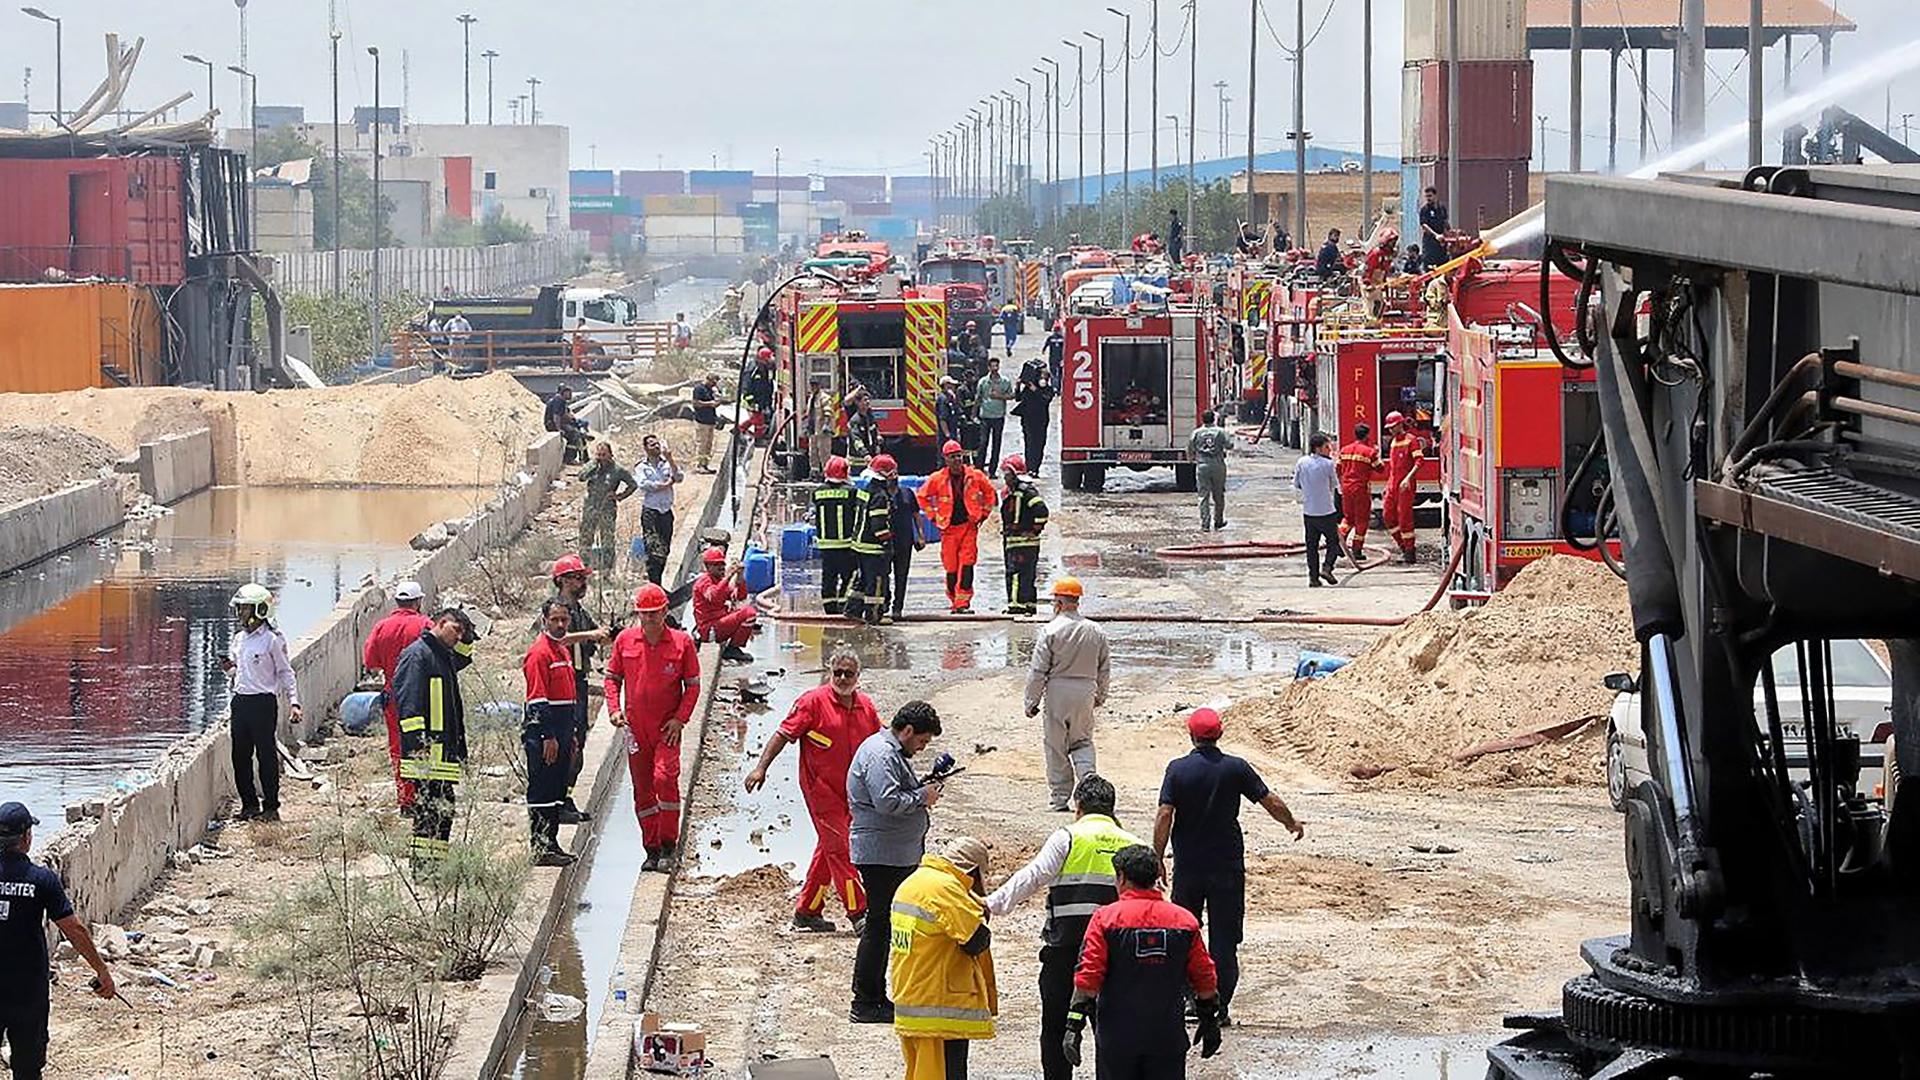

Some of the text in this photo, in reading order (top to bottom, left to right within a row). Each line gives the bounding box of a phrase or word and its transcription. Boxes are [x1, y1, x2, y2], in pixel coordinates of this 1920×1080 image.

[1072, 319, 1094, 410] 125
[1354, 367, 1366, 419] FIR
[891, 929, 909, 949] RAN
